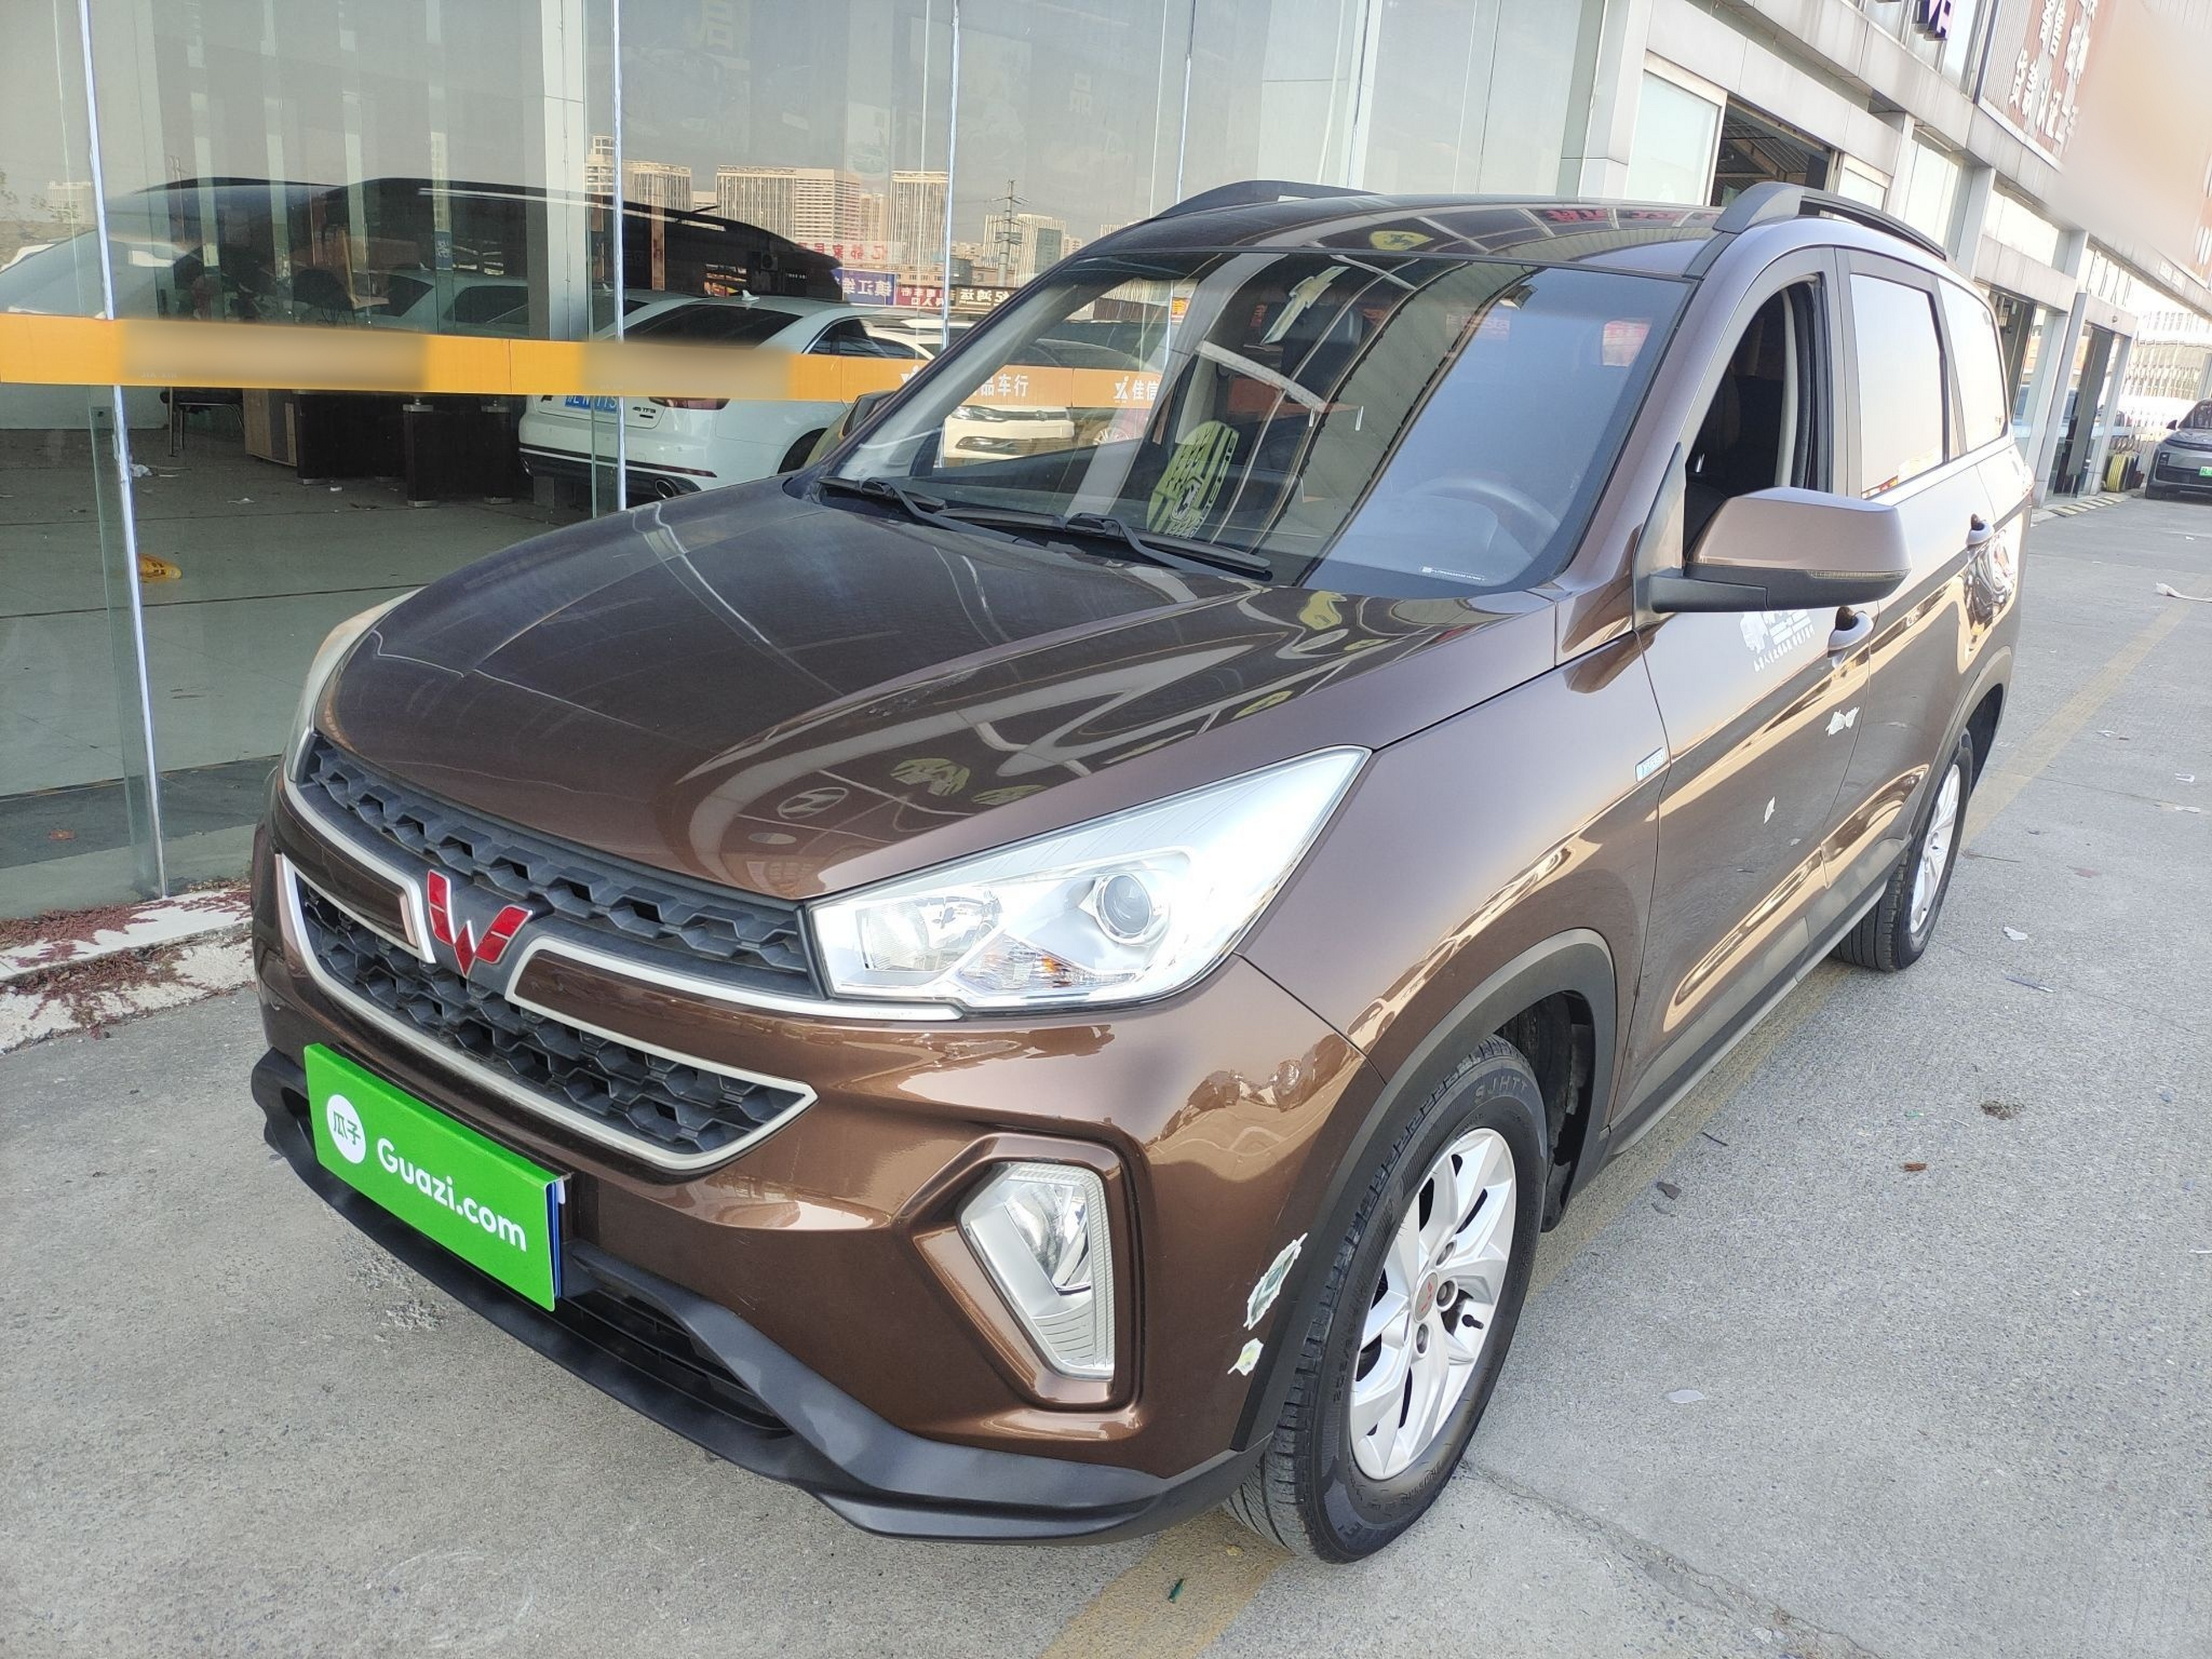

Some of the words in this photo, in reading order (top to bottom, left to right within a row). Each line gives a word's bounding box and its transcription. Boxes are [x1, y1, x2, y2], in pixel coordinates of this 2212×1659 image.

[972, 374, 1029, 397] 品车行
[333, 1111, 361, 1146] 瓜子
[377, 1138, 527, 1252] Guazi.com
